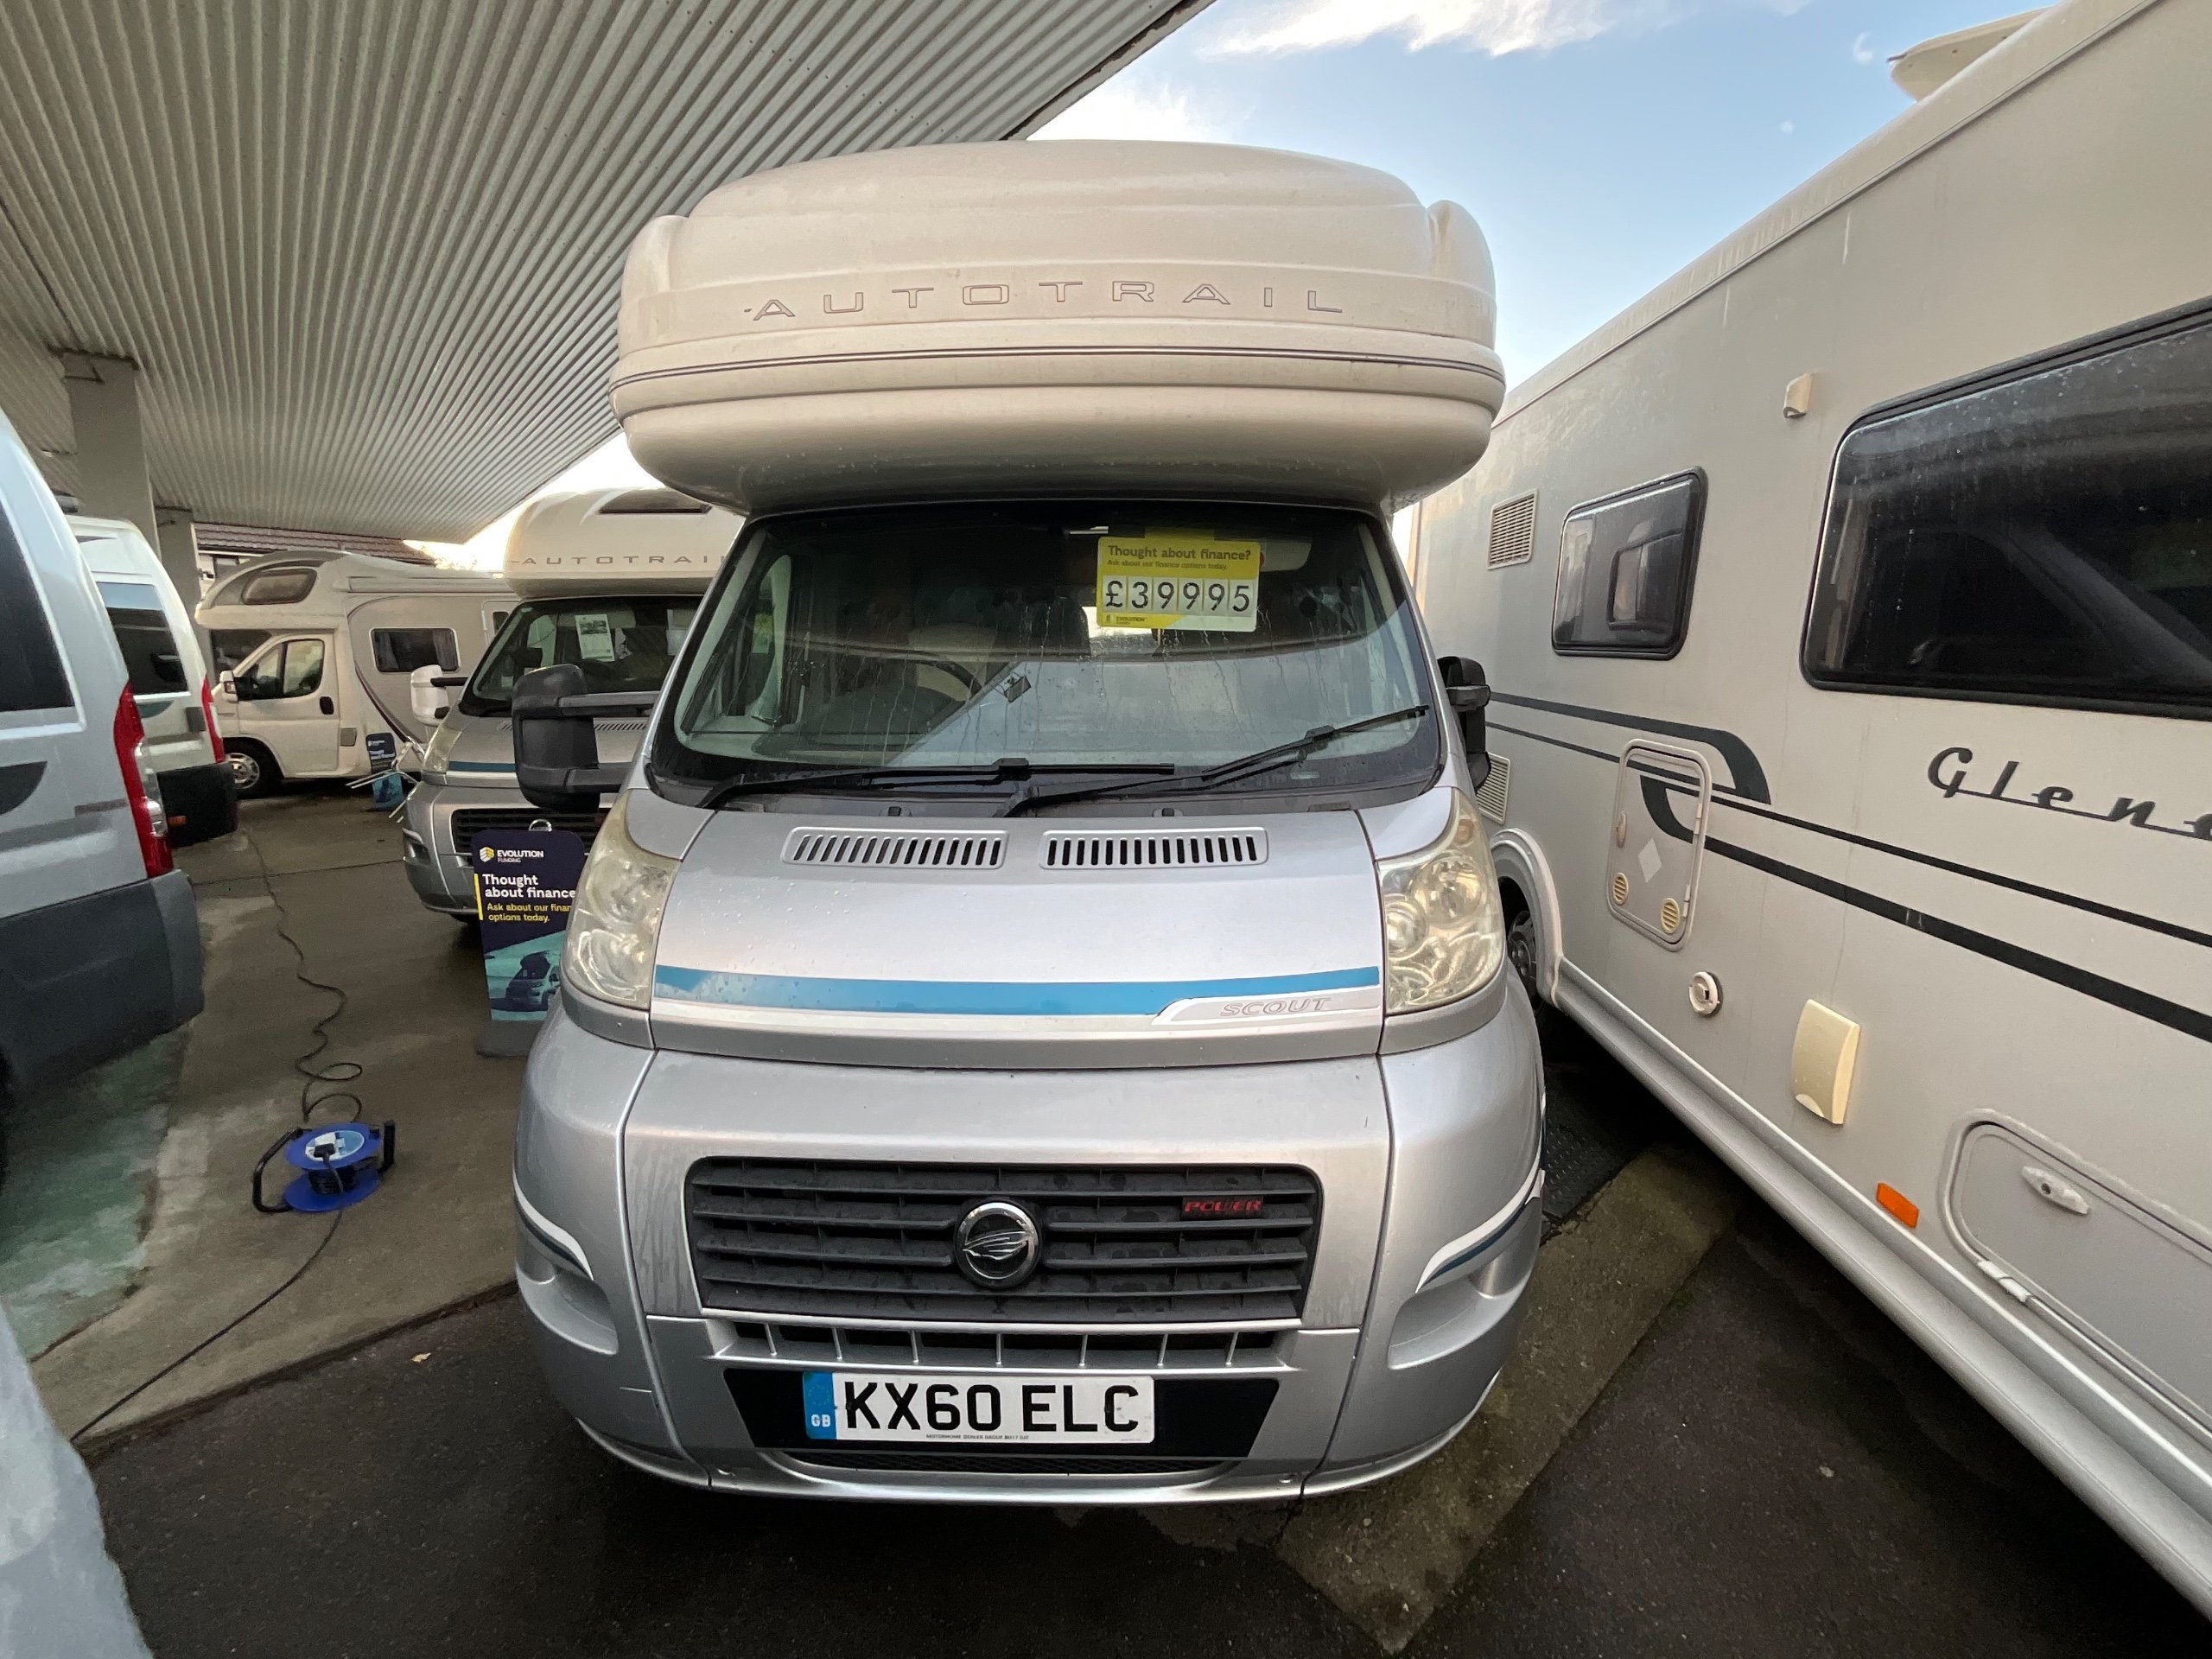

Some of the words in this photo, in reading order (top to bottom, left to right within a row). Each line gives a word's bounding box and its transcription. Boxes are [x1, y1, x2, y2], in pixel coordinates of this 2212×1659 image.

[753, 280, 1344, 321] AUTOTRAIL
[1108, 545, 1158, 559] Thought
[1161, 547, 1197, 558] about
[1201, 548, 1251, 560] finance?
[1105, 580, 1249, 612] £39995
[497, 849, 544, 858] EVOLUTION
[482, 874, 539, 887] Thought
[485, 887, 524, 898] about
[505, 903, 531, 912] about
[488, 913, 521, 922] options
[523, 913, 550, 924] today.
[1220, 997, 1332, 1017] SCOUT
[844, 1382, 1001, 1432] KX60
[1021, 1384, 1140, 1433] ELC
[811, 1414, 831, 1427] GB
